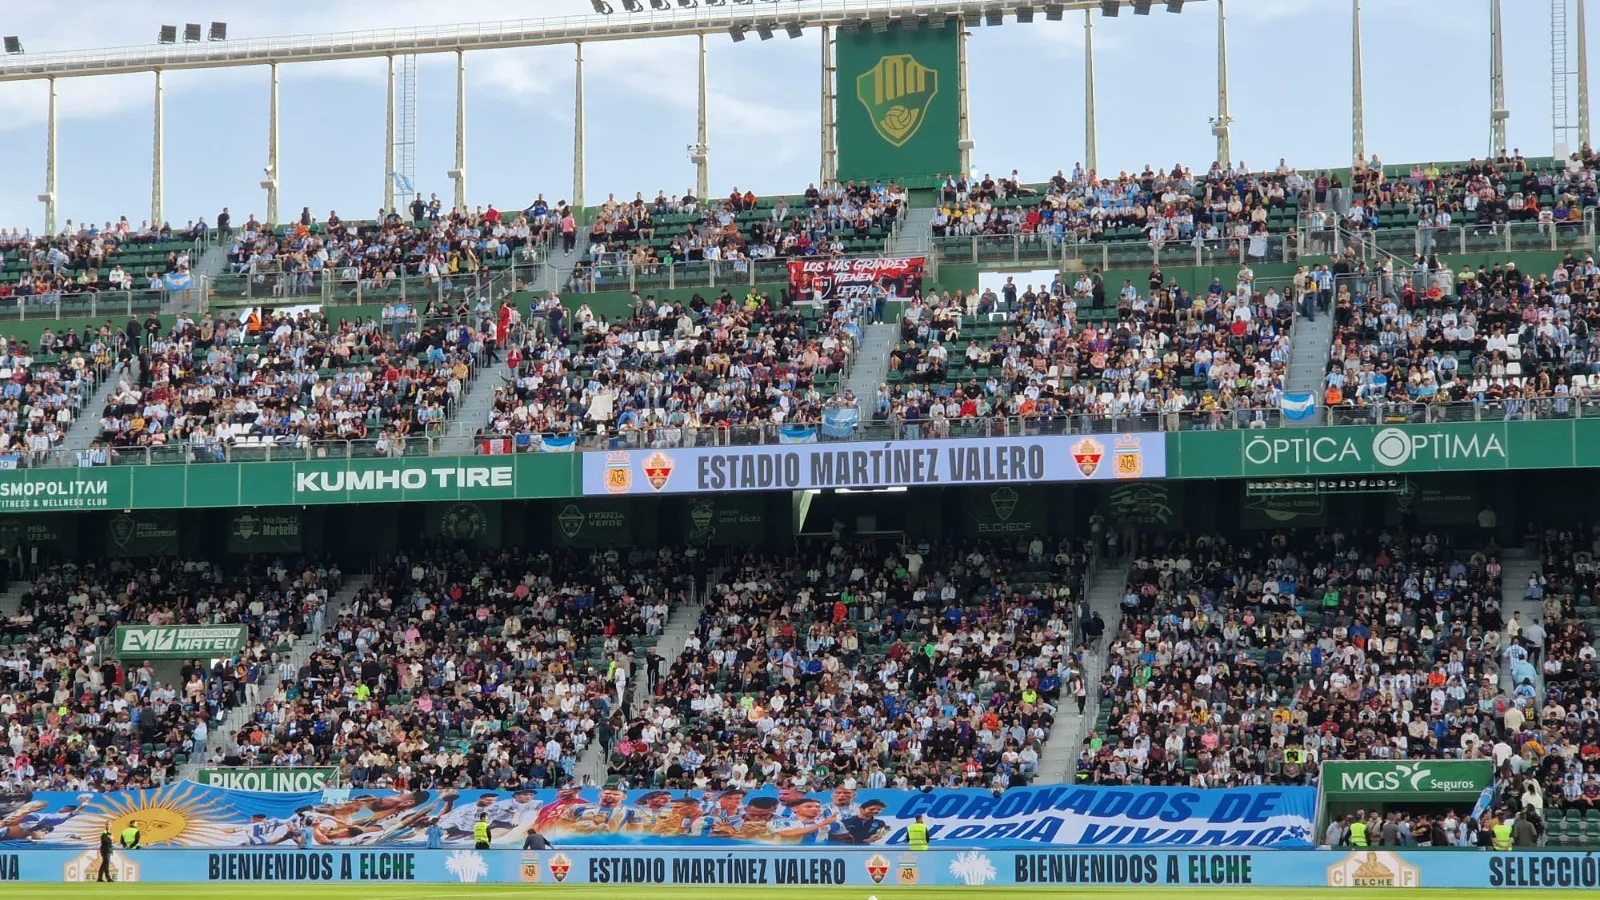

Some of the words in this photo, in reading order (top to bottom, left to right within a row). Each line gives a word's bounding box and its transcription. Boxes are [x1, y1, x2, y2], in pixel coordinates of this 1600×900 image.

[803, 261, 826, 272] LOS
[853, 257, 911, 271] GRANDES
[834, 271, 876, 283] TIENEN
[697, 452, 800, 490] ESTADIO
[810, 442, 939, 486] MARTÍNEZ
[949, 444, 1044, 481] VALERO
[297, 468, 427, 492] KUMHO
[432, 466, 513, 488] TIRE
[42, 498, 84, 507] WELLNESS
[87, 498, 108, 506] CLUB
[262, 524, 298, 536] Marbella
[588, 519, 622, 528] VERDE
[182, 629, 237, 637] ELECTRICIDAD
[174, 638, 239, 650] MATEU
[209, 772, 325, 792] PIKOLINOS
[1341, 772, 1400, 791] MGS
[1430, 779, 1474, 792] Seguros
[896, 786, 1200, 823] CORONADOS
[1207, 791, 1282, 824] DE
[1077, 823, 1308, 846] VIVAMO
[208, 853, 333, 881] BIENVENIDOS
[340, 853, 352, 880] A
[359, 853, 415, 880] ELCHE
[589, 857, 665, 884] ESTADIO
[672, 853, 768, 884] MARTÍNEZ
[774, 858, 846, 885] VALERO
[1014, 854, 1158, 884] BIENVENIDOS
[1166, 854, 1180, 884] A
[1188, 854, 1252, 884] ELCHE
[1489, 852, 1600, 887] SELECCIÓ
[1354, 878, 1393, 886] ELCHE
